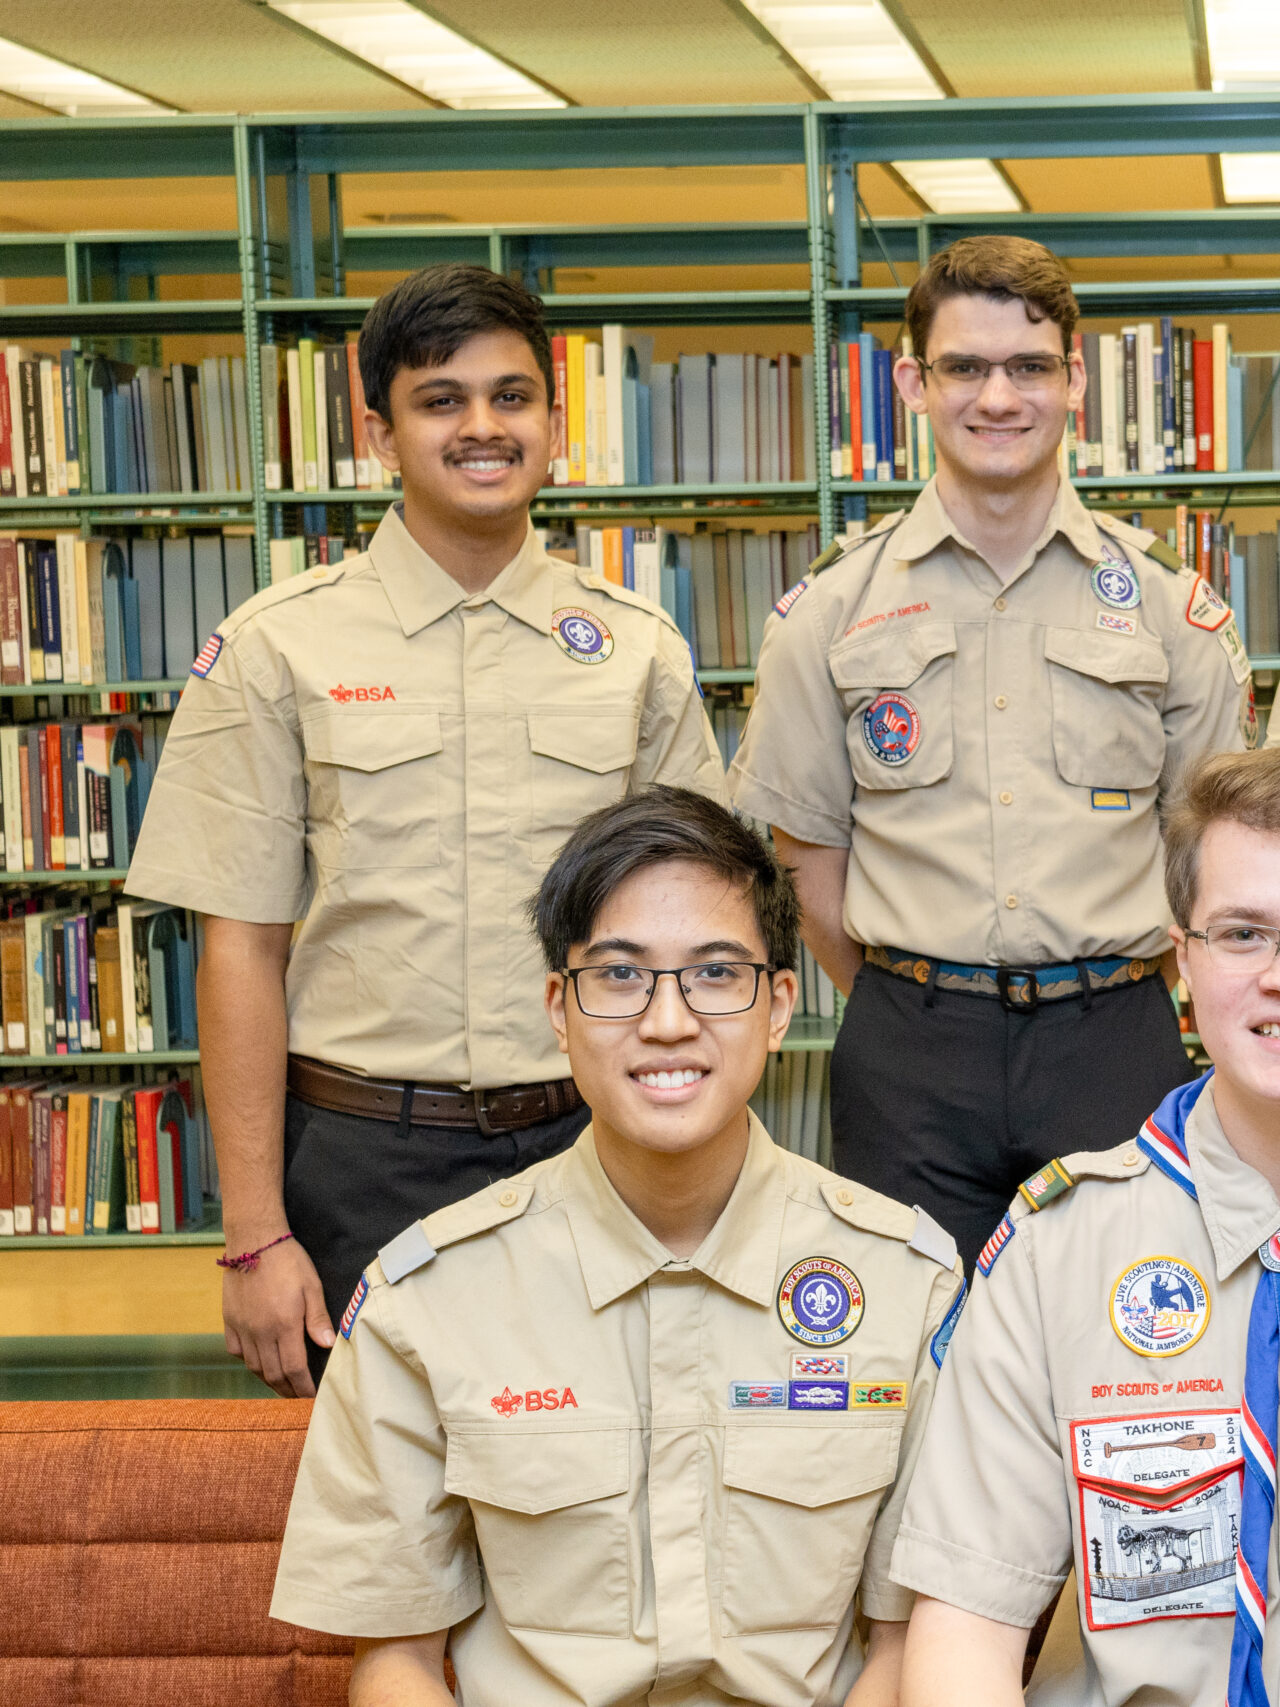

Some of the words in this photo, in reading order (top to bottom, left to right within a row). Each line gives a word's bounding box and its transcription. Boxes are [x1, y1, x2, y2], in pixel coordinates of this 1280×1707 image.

[355, 686, 397, 702] BSA
[783, 1276, 796, 1294] BOY
[793, 1261, 822, 1280] SCOUTS
[831, 1265, 860, 1300] AMERICA
[1115, 1283, 1128, 1303] LIVE
[1124, 1260, 1172, 1286] SCOUTING'S
[1173, 1265, 1206, 1308] ADVENTURE
[1157, 1311, 1199, 1330] 2017
[798, 1329, 823, 1343] SINCE
[825, 1330, 842, 1343] 1910
[1122, 1325, 1154, 1350] NATIONAL
[1155, 1331, 1194, 1350] JAMBOREE
[1091, 1384, 1113, 1398] BOY
[1117, 1382, 1159, 1396] SCOUTS
[1176, 1378, 1224, 1394] AMERICA
[525, 1387, 579, 1411] BSA
[1123, 1420, 1195, 1436] TAKHONE
[1226, 1417, 1237, 1455] 2024
[1197, 1436, 1206, 1447] 7
[1133, 1469, 1190, 1482] DELEGATE
[1098, 1496, 1130, 1513] NOAC
[1195, 1485, 1222, 1506] 2024
[1143, 1601, 1204, 1615] DELEGATE
